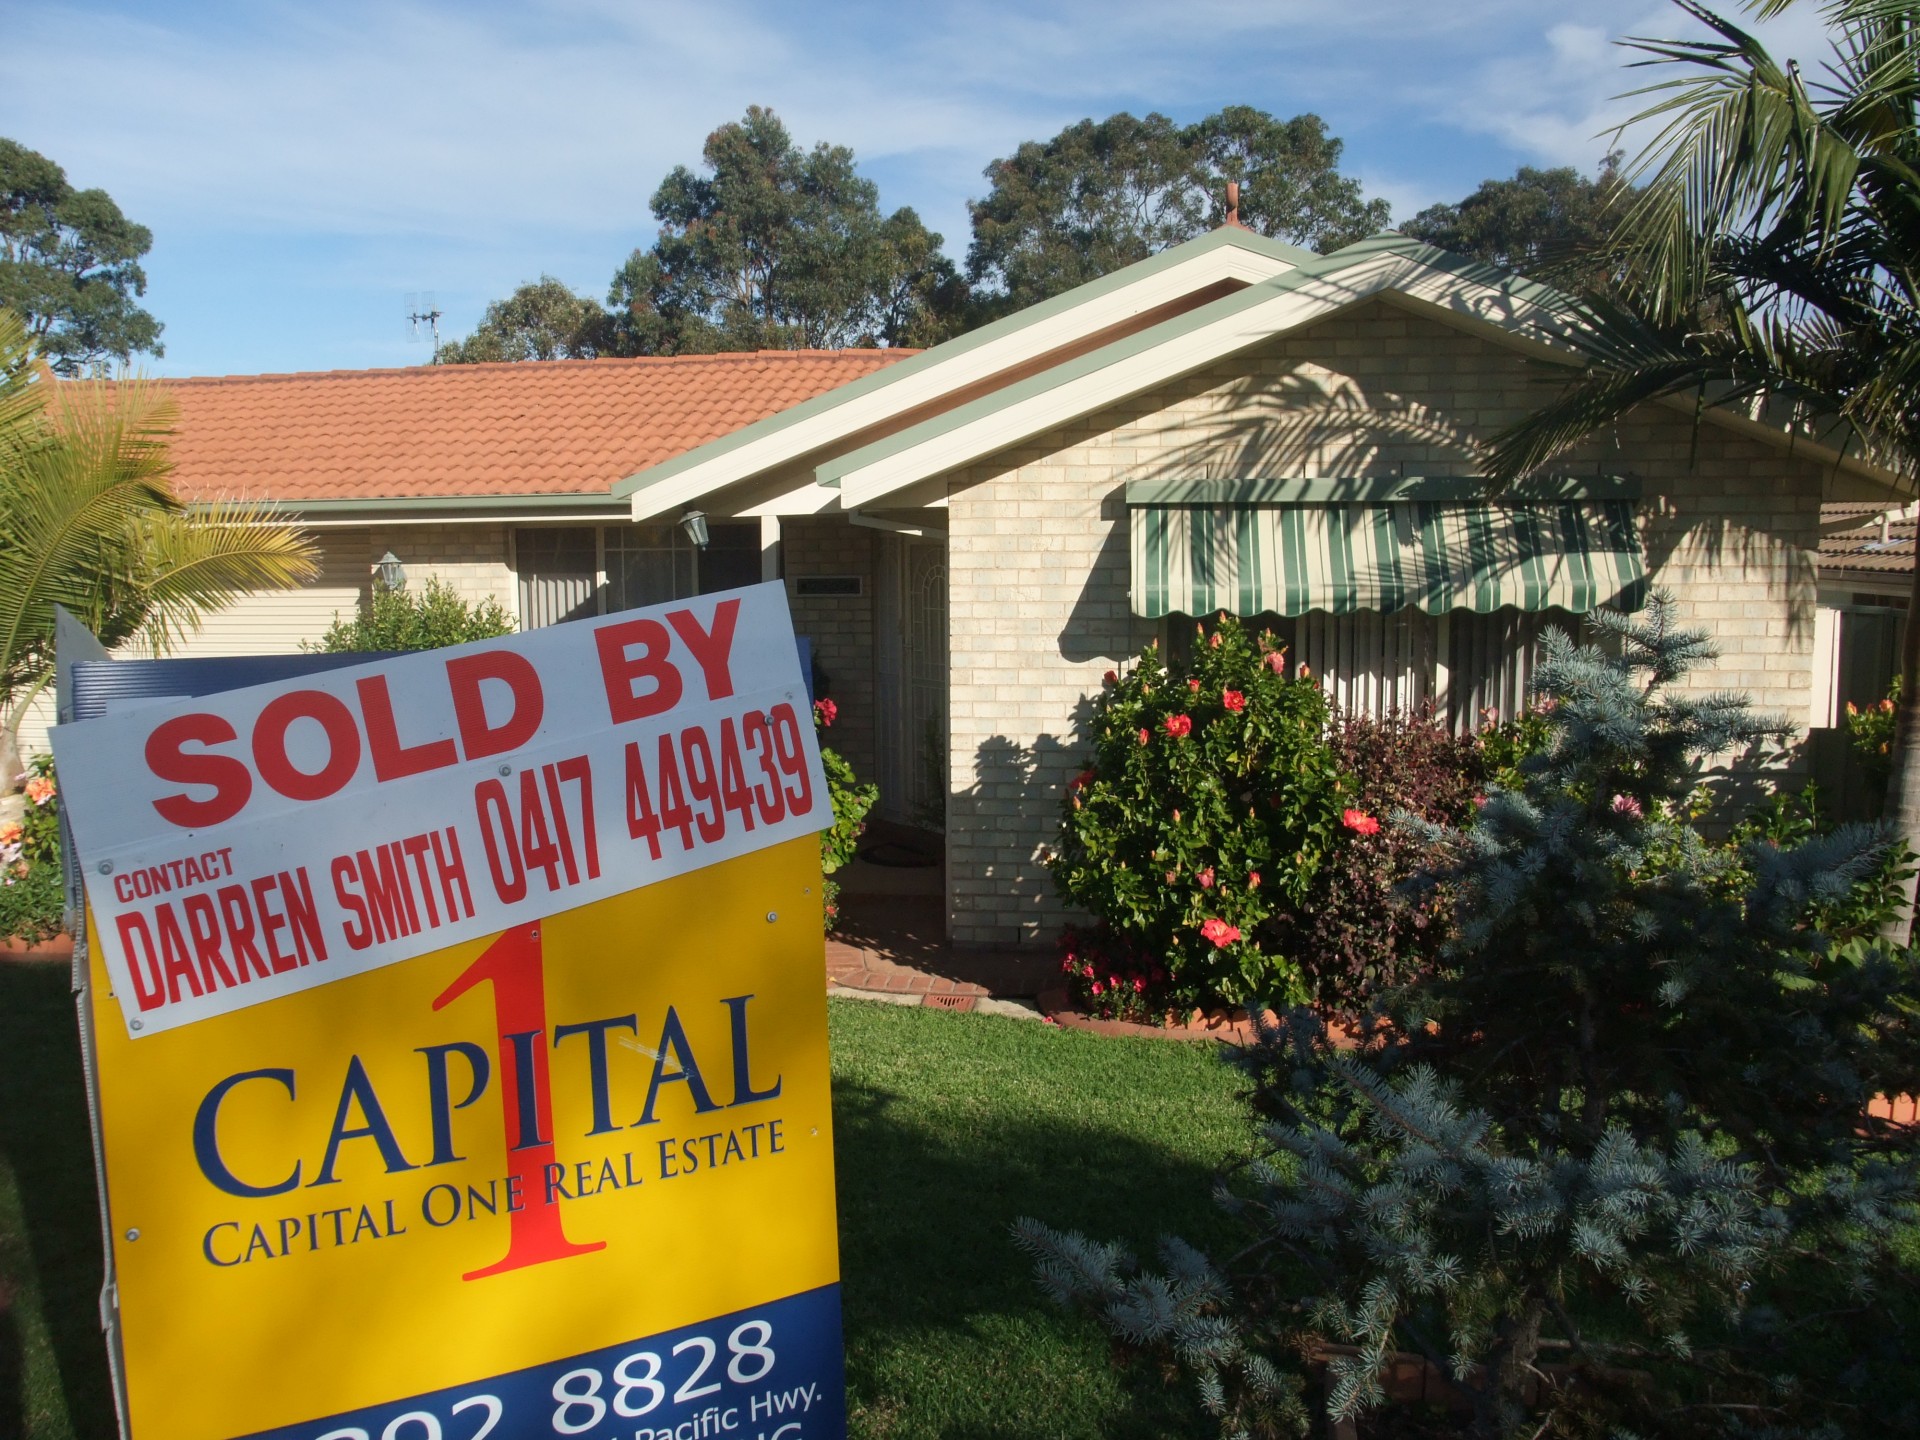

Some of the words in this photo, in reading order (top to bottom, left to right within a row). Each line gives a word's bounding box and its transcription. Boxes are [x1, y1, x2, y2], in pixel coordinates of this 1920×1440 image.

[145, 650, 544, 828] SOLD
[594, 599, 741, 725] BY
[115, 867, 328, 1012] DARREN
[332, 827, 476, 951] SMITH
[475, 755, 601, 905] 0417
[625, 703, 813, 860] 449439
[115, 848, 233, 903] CONTACT
[193, 994, 782, 1198] CAPITAL
[202, 1200, 406, 1268] CAPITAL
[421, 1175, 526, 1227] ONE
[544, 1153, 643, 1205] REAL
[658, 1119, 785, 1180] ESTATE
[551, 1320, 776, 1435] 8828
[750, 1382, 822, 1422] Hwy.
